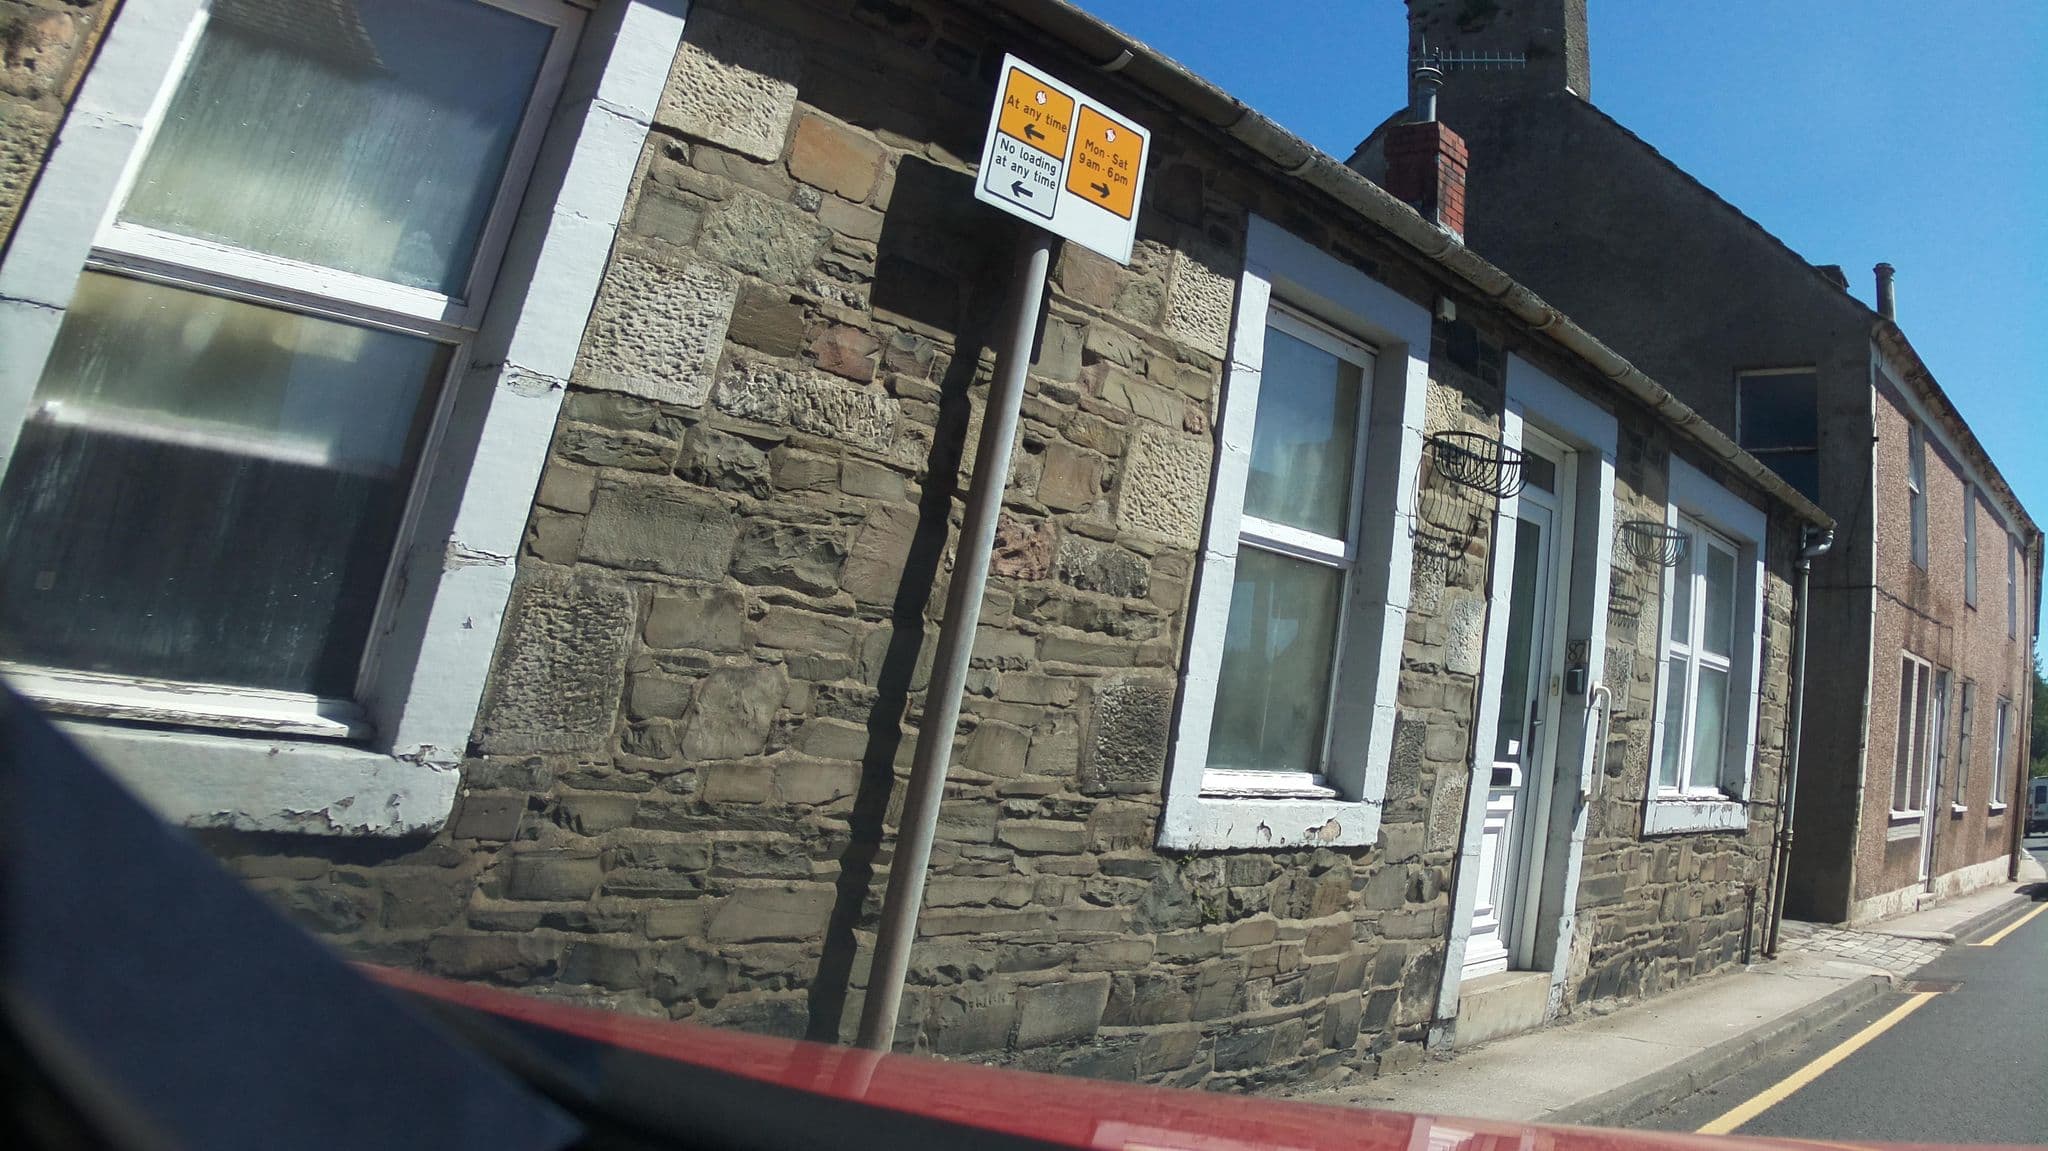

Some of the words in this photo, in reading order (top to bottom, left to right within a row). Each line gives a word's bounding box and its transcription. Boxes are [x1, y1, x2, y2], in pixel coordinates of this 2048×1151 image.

[1007, 95, 1020, 110] At
[1024, 104, 1041, 121] any
[1046, 113, 1068, 133] time
[995, 154, 1007, 168] at
[1011, 160, 1029, 178] any
[1034, 171, 1056, 190] time
[1000, 138, 1015, 153] No
[1020, 147, 1057, 176] loading
[1085, 139, 1105, 159] Mon
[1112, 154, 1128, 171] Sat
